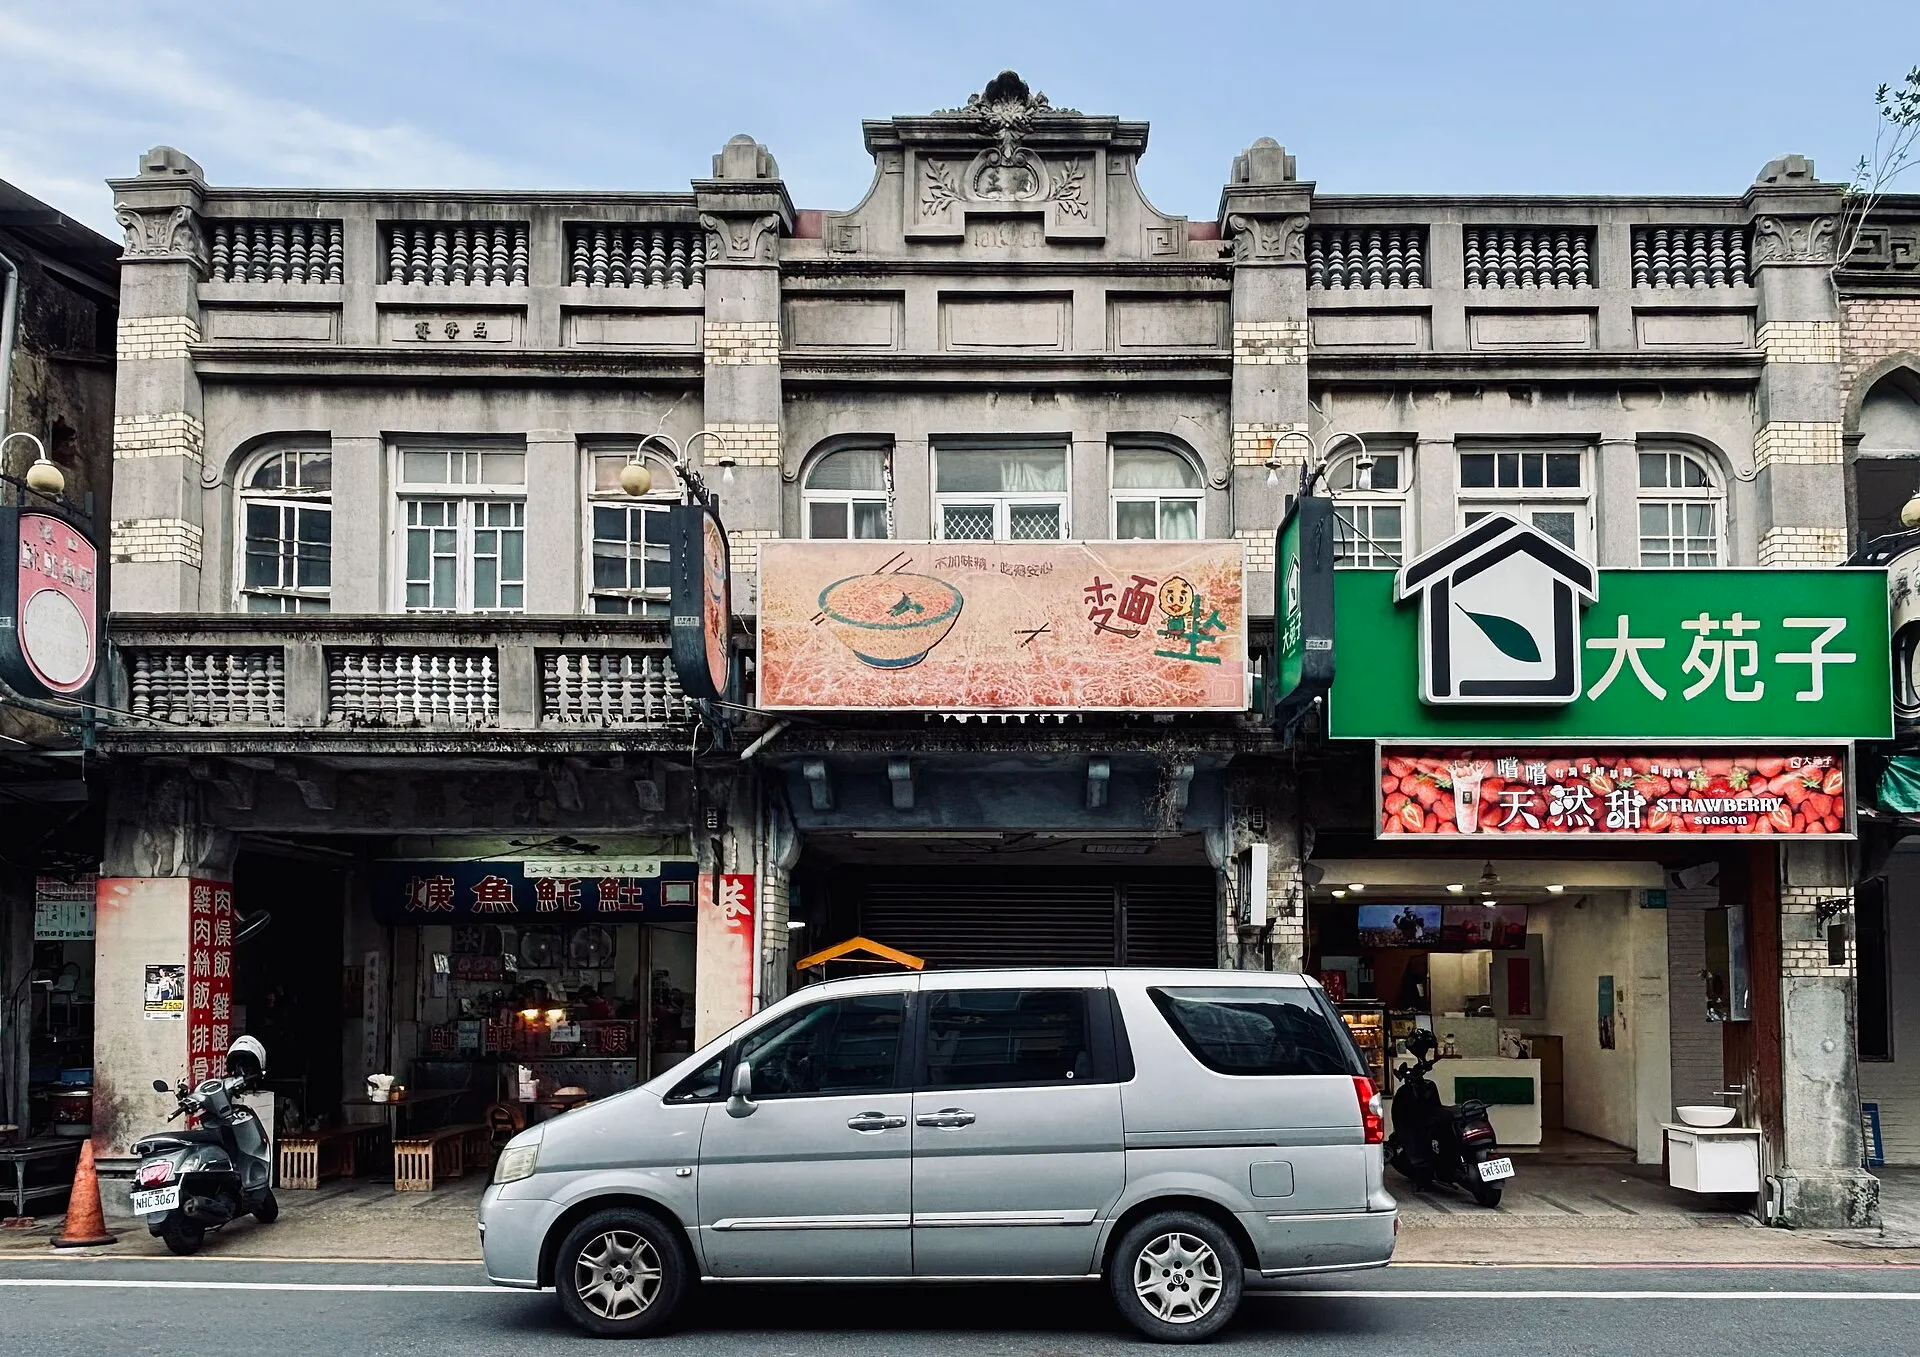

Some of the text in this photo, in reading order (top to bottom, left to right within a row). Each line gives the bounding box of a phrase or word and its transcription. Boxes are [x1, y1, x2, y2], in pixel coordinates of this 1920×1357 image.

[1585, 611, 1858, 703] 大苑子
[1497, 784, 1647, 829] 天然甜
[1656, 798, 1784, 813] STRAWBERRY
[1694, 815, 1748, 825] season
